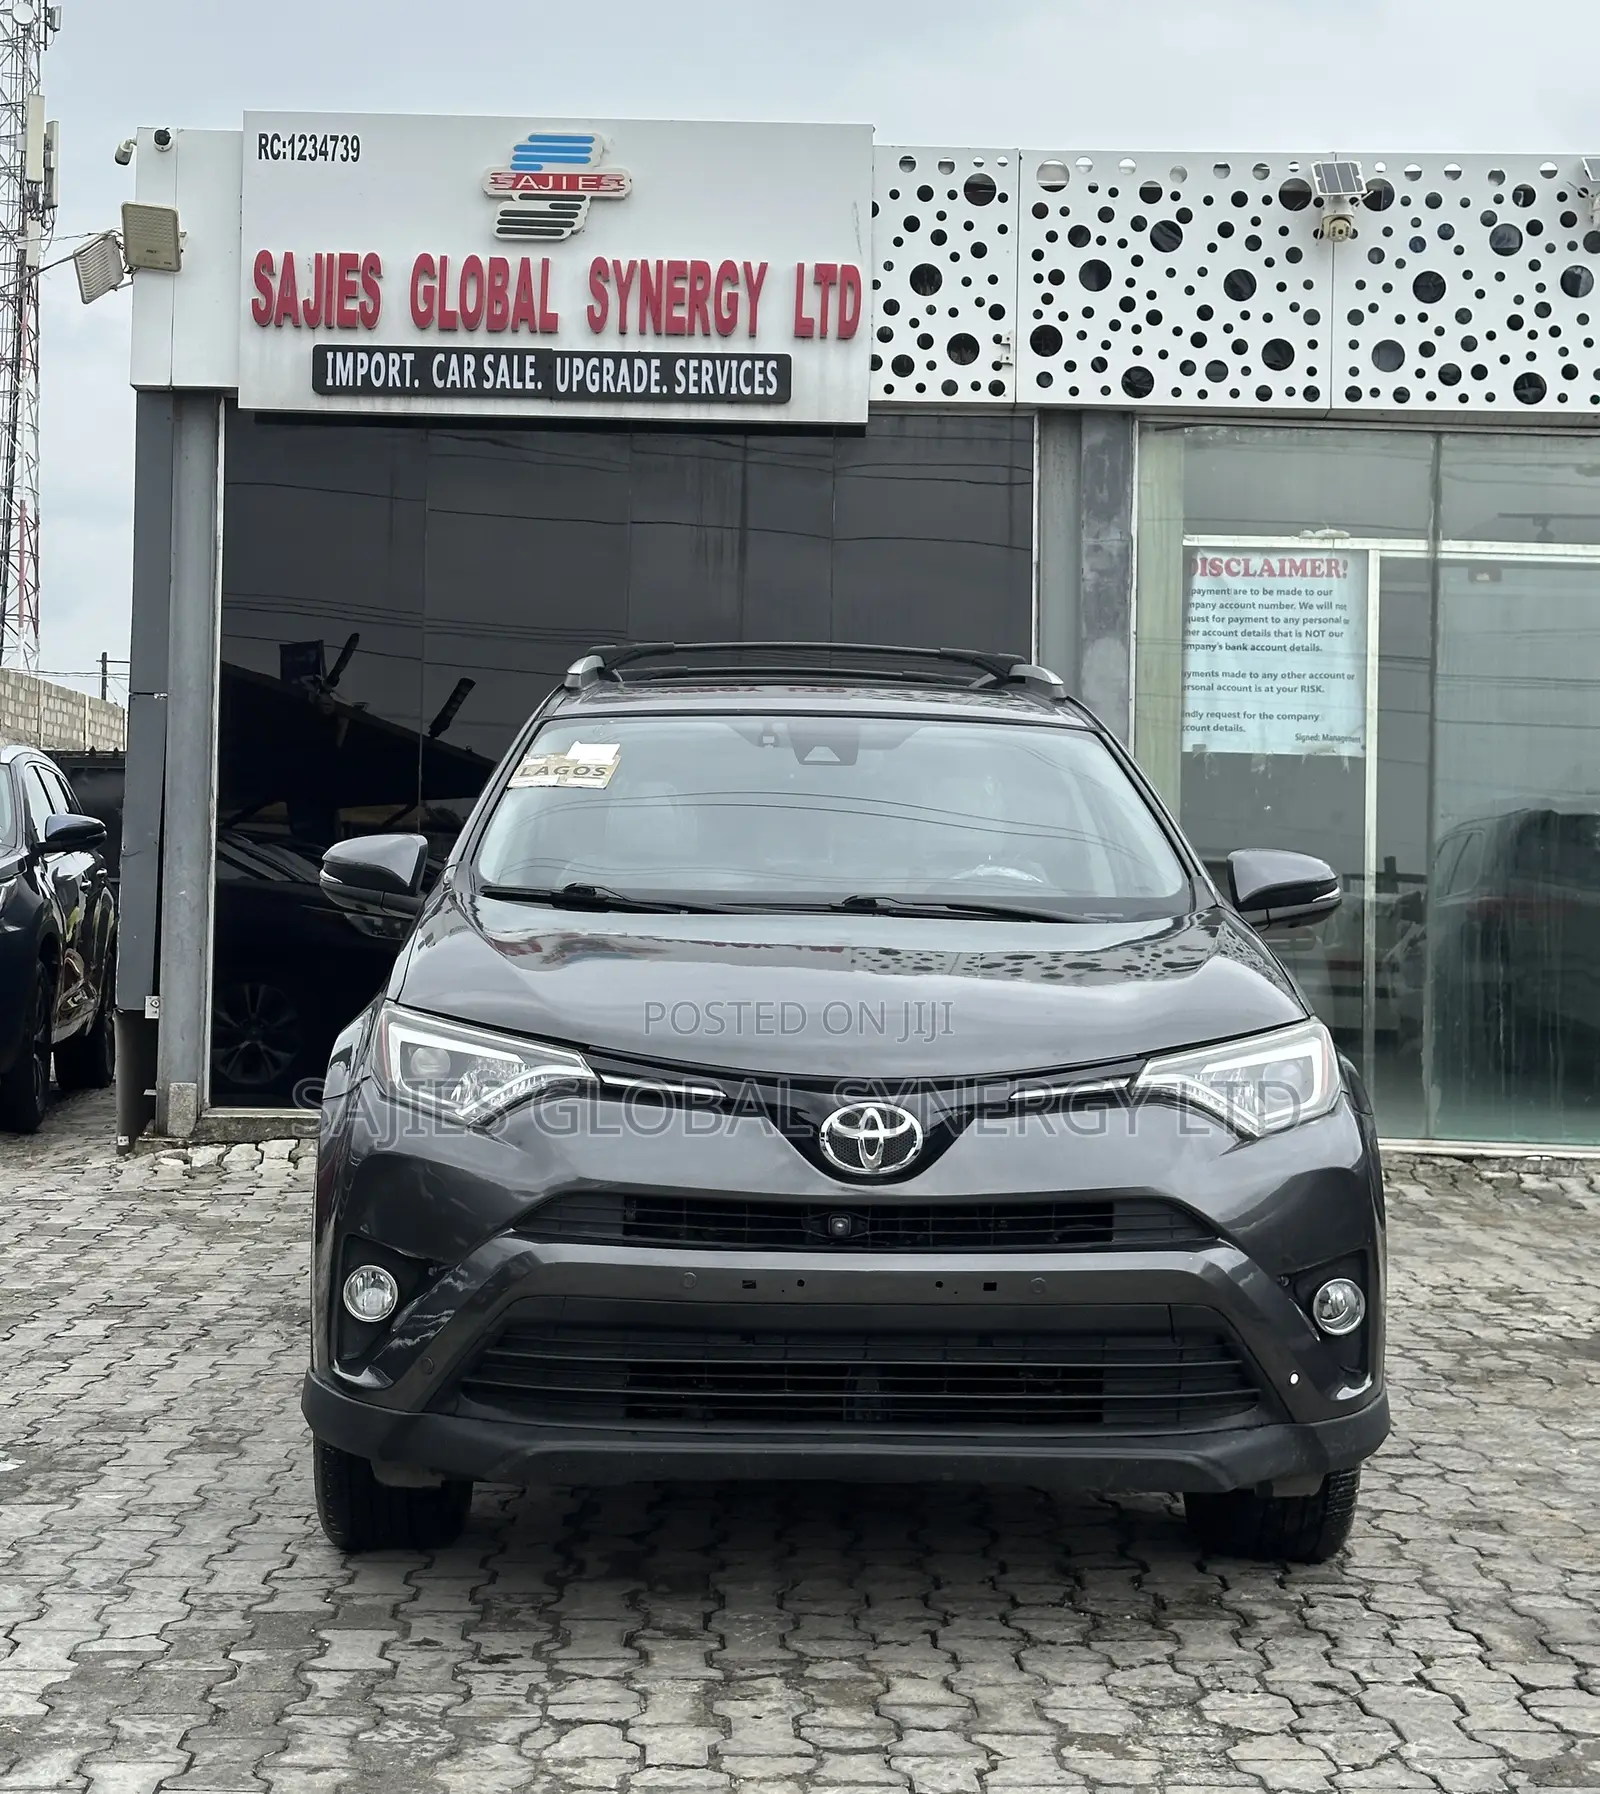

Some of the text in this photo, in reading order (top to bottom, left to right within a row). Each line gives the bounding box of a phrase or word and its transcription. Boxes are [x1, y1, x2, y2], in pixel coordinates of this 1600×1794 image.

[257, 132, 361, 163] RC:1234739
[488, 173, 626, 191] SAJIES
[251, 249, 863, 340] SAJIES GLOBAL SYNERGY LTD
[325, 350, 779, 397] IMPORT. CAR SALE. UPGRADE. SERVICES
[1233, 588, 1248, 596] are
[1250, 588, 1260, 596] to
[1262, 587, 1274, 596] be
[1276, 587, 1303, 596] made
[1305, 588, 1315, 596] to
[1219, 602, 1256, 610] account
[1258, 601, 1297, 610] number.
[1299, 601, 1314, 610] We
[1316, 601, 1333, 610] will
[1212, 614, 1225, 623] for
[1227, 616, 1268, 625] payment
[1271, 616, 1281, 624] to
[1283, 617, 1300, 626] any
[1302, 616, 1342, 626] personal
[1202, 629, 1238, 637] account
[1240, 628, 1271, 637] details
[1273, 629, 1293, 638] that
[1295, 629, 1302, 638] is
[1305, 629, 1326, 638] NOT
[1328, 630, 1344, 638] our
[1225, 642, 1248, 651] bank
[1250, 643, 1287, 652] account
[1289, 643, 1323, 652] details.
[1221, 670, 1247, 679] made
[1249, 671, 1259, 679] to
[1261, 672, 1278, 681] any
[1280, 671, 1307, 680] other
[1308, 672, 1345, 680] account
[1216, 684, 1252, 692] account
[1254, 684, 1262, 693] is
[1264, 685, 1274, 693] at
[1276, 686, 1298, 695] your
[1300, 685, 1325, 693] RISK.
[1206, 711, 1241, 720] request
[1243, 710, 1257, 720] for
[1258, 711, 1274, 720] the
[1276, 713, 1320, 722] company
[1213, 724, 1246, 733] details.
[519, 765, 608, 777] LAGOS
